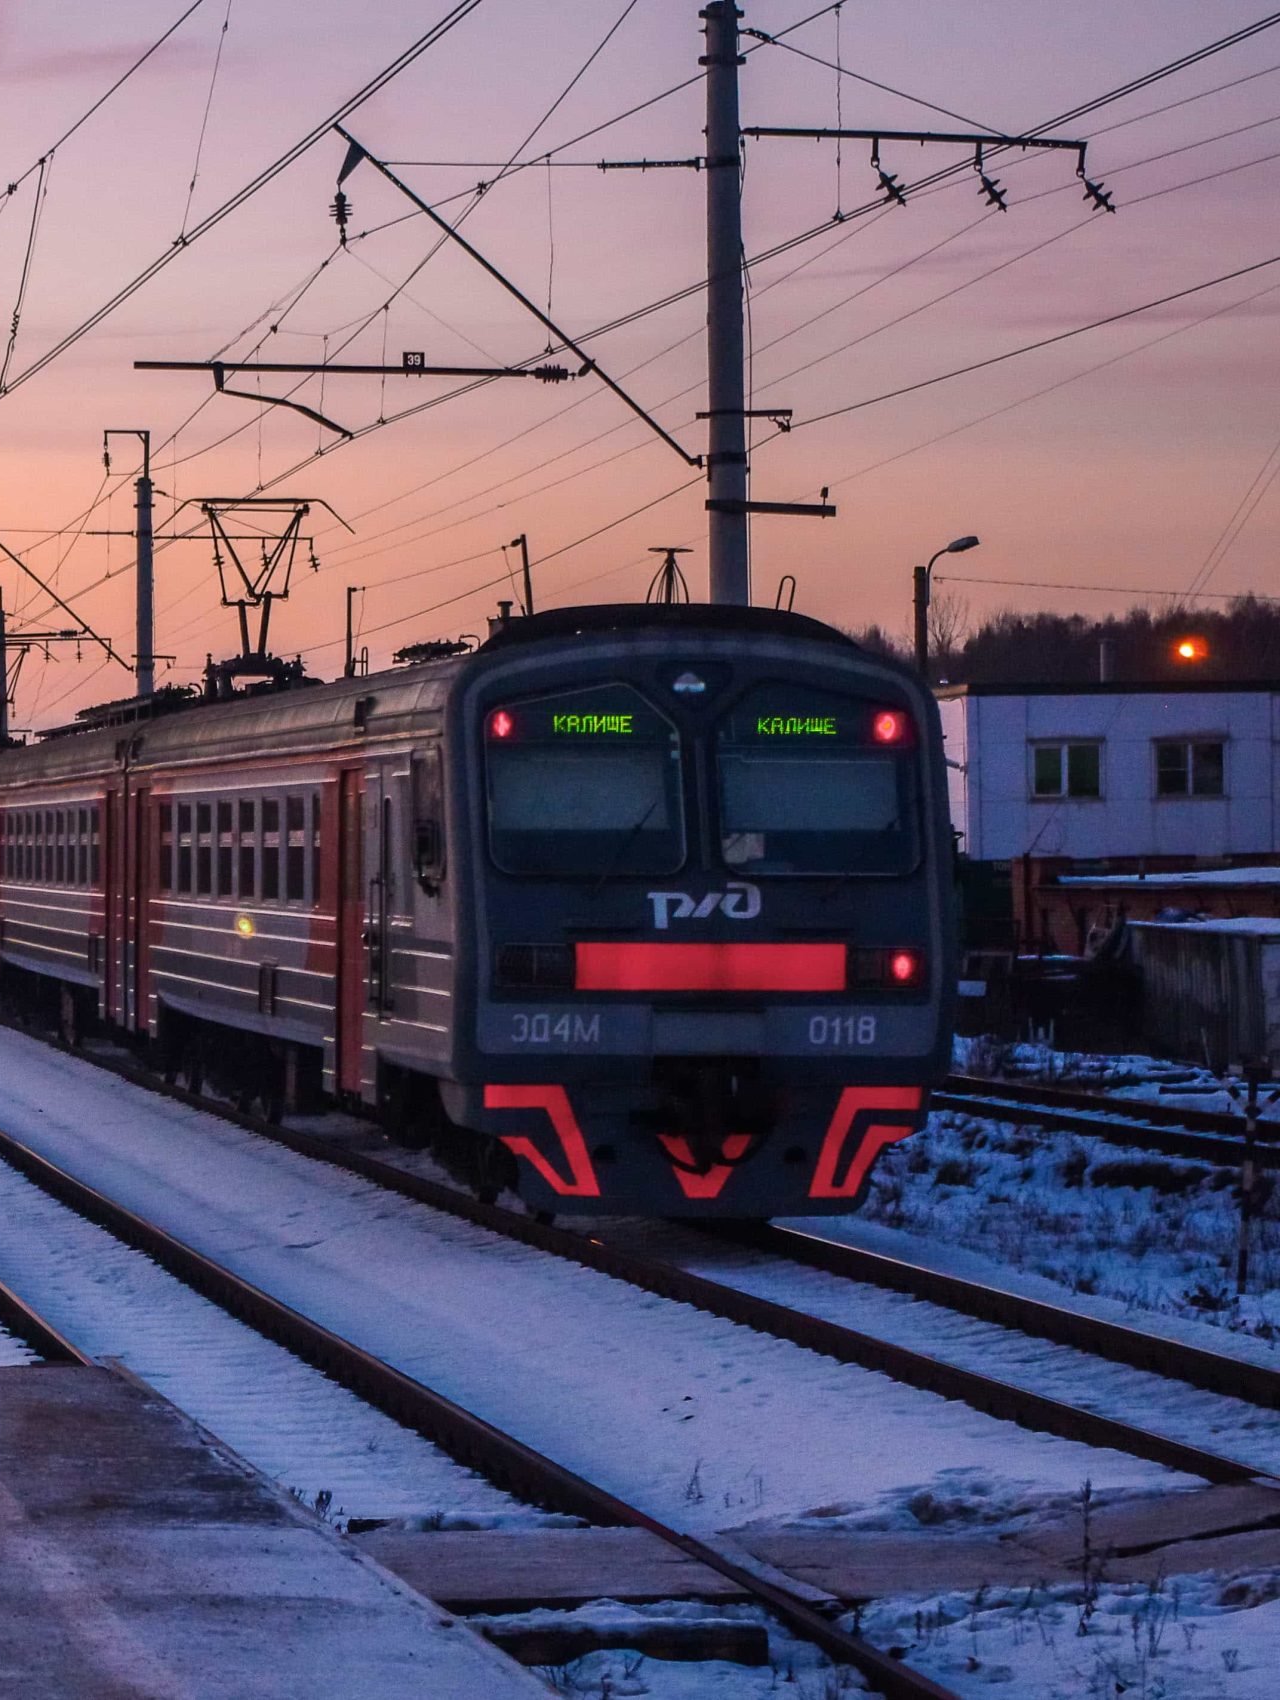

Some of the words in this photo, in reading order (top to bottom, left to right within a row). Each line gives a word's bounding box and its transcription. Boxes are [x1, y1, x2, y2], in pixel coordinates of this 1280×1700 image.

[407, 354, 421, 366] 39
[510, 1013, 601, 1043] ЭД4М
[809, 1015, 876, 1045] 0118
